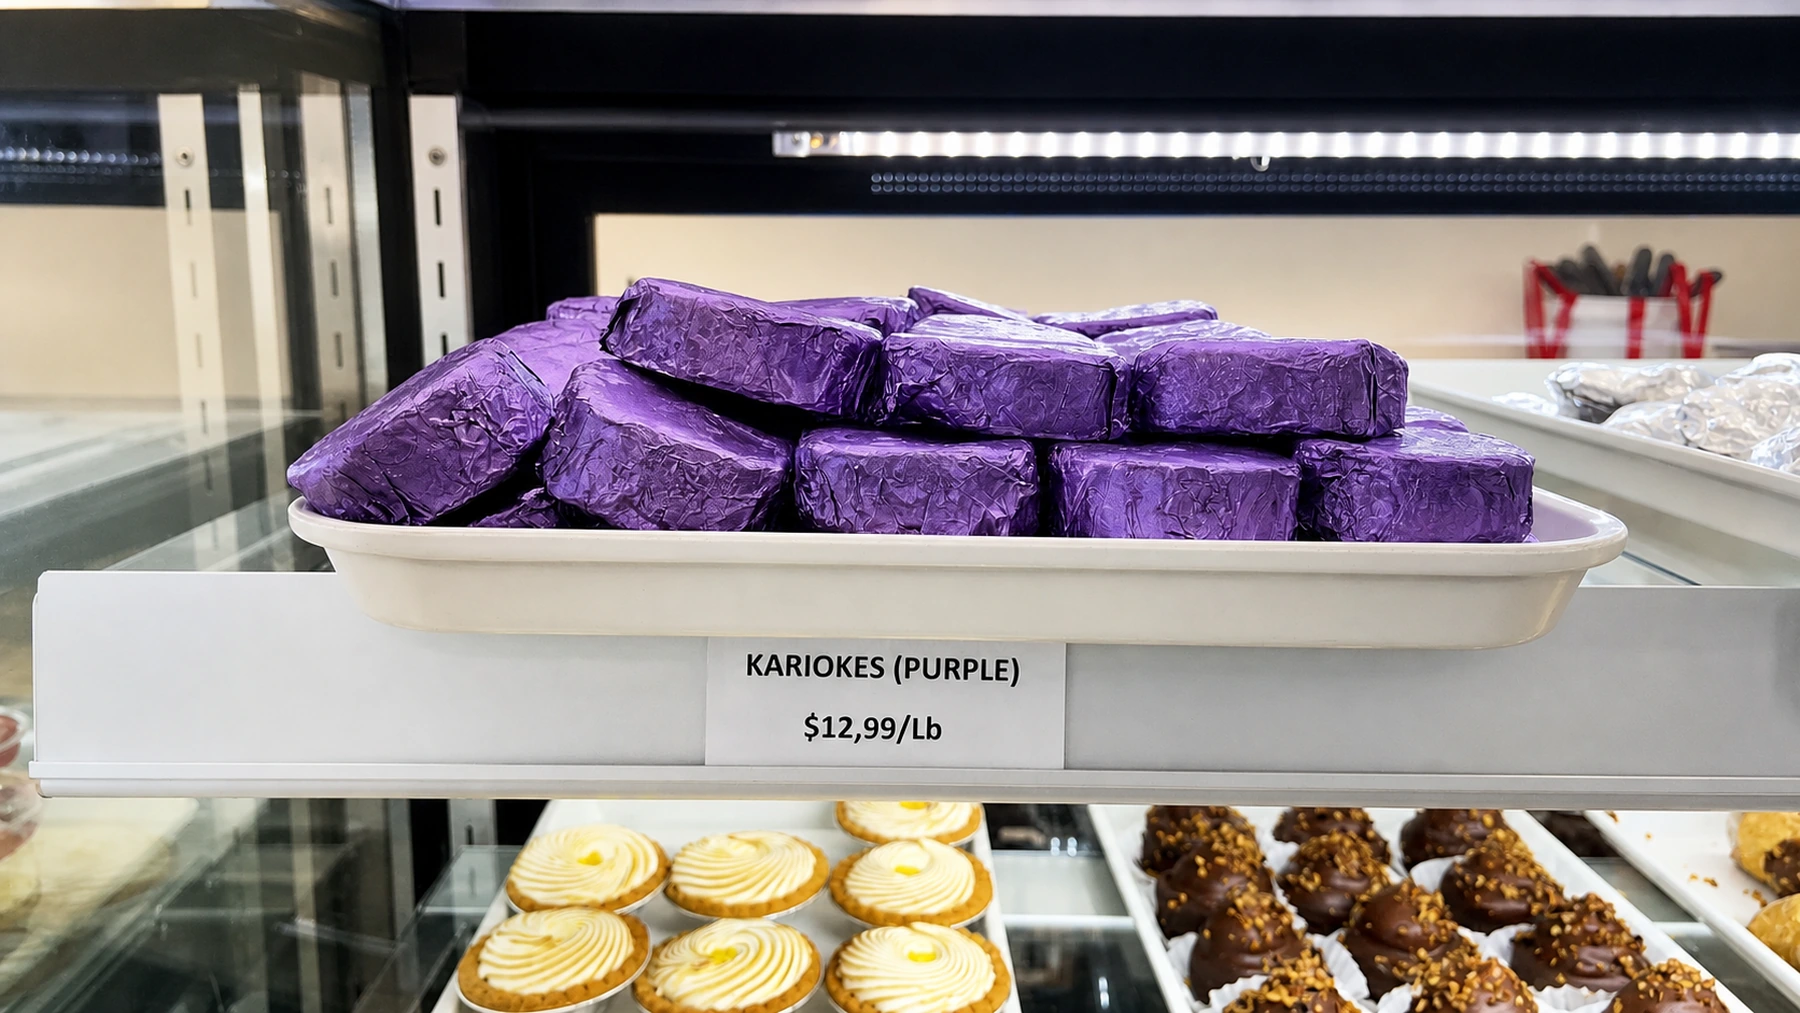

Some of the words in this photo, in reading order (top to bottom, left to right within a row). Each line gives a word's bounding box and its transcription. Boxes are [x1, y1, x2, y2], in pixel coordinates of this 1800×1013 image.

[746, 653, 885, 679] KARIOKES
[893, 654, 1020, 688] (PURPLE)
[804, 712, 942, 745] $12,99/Lb
